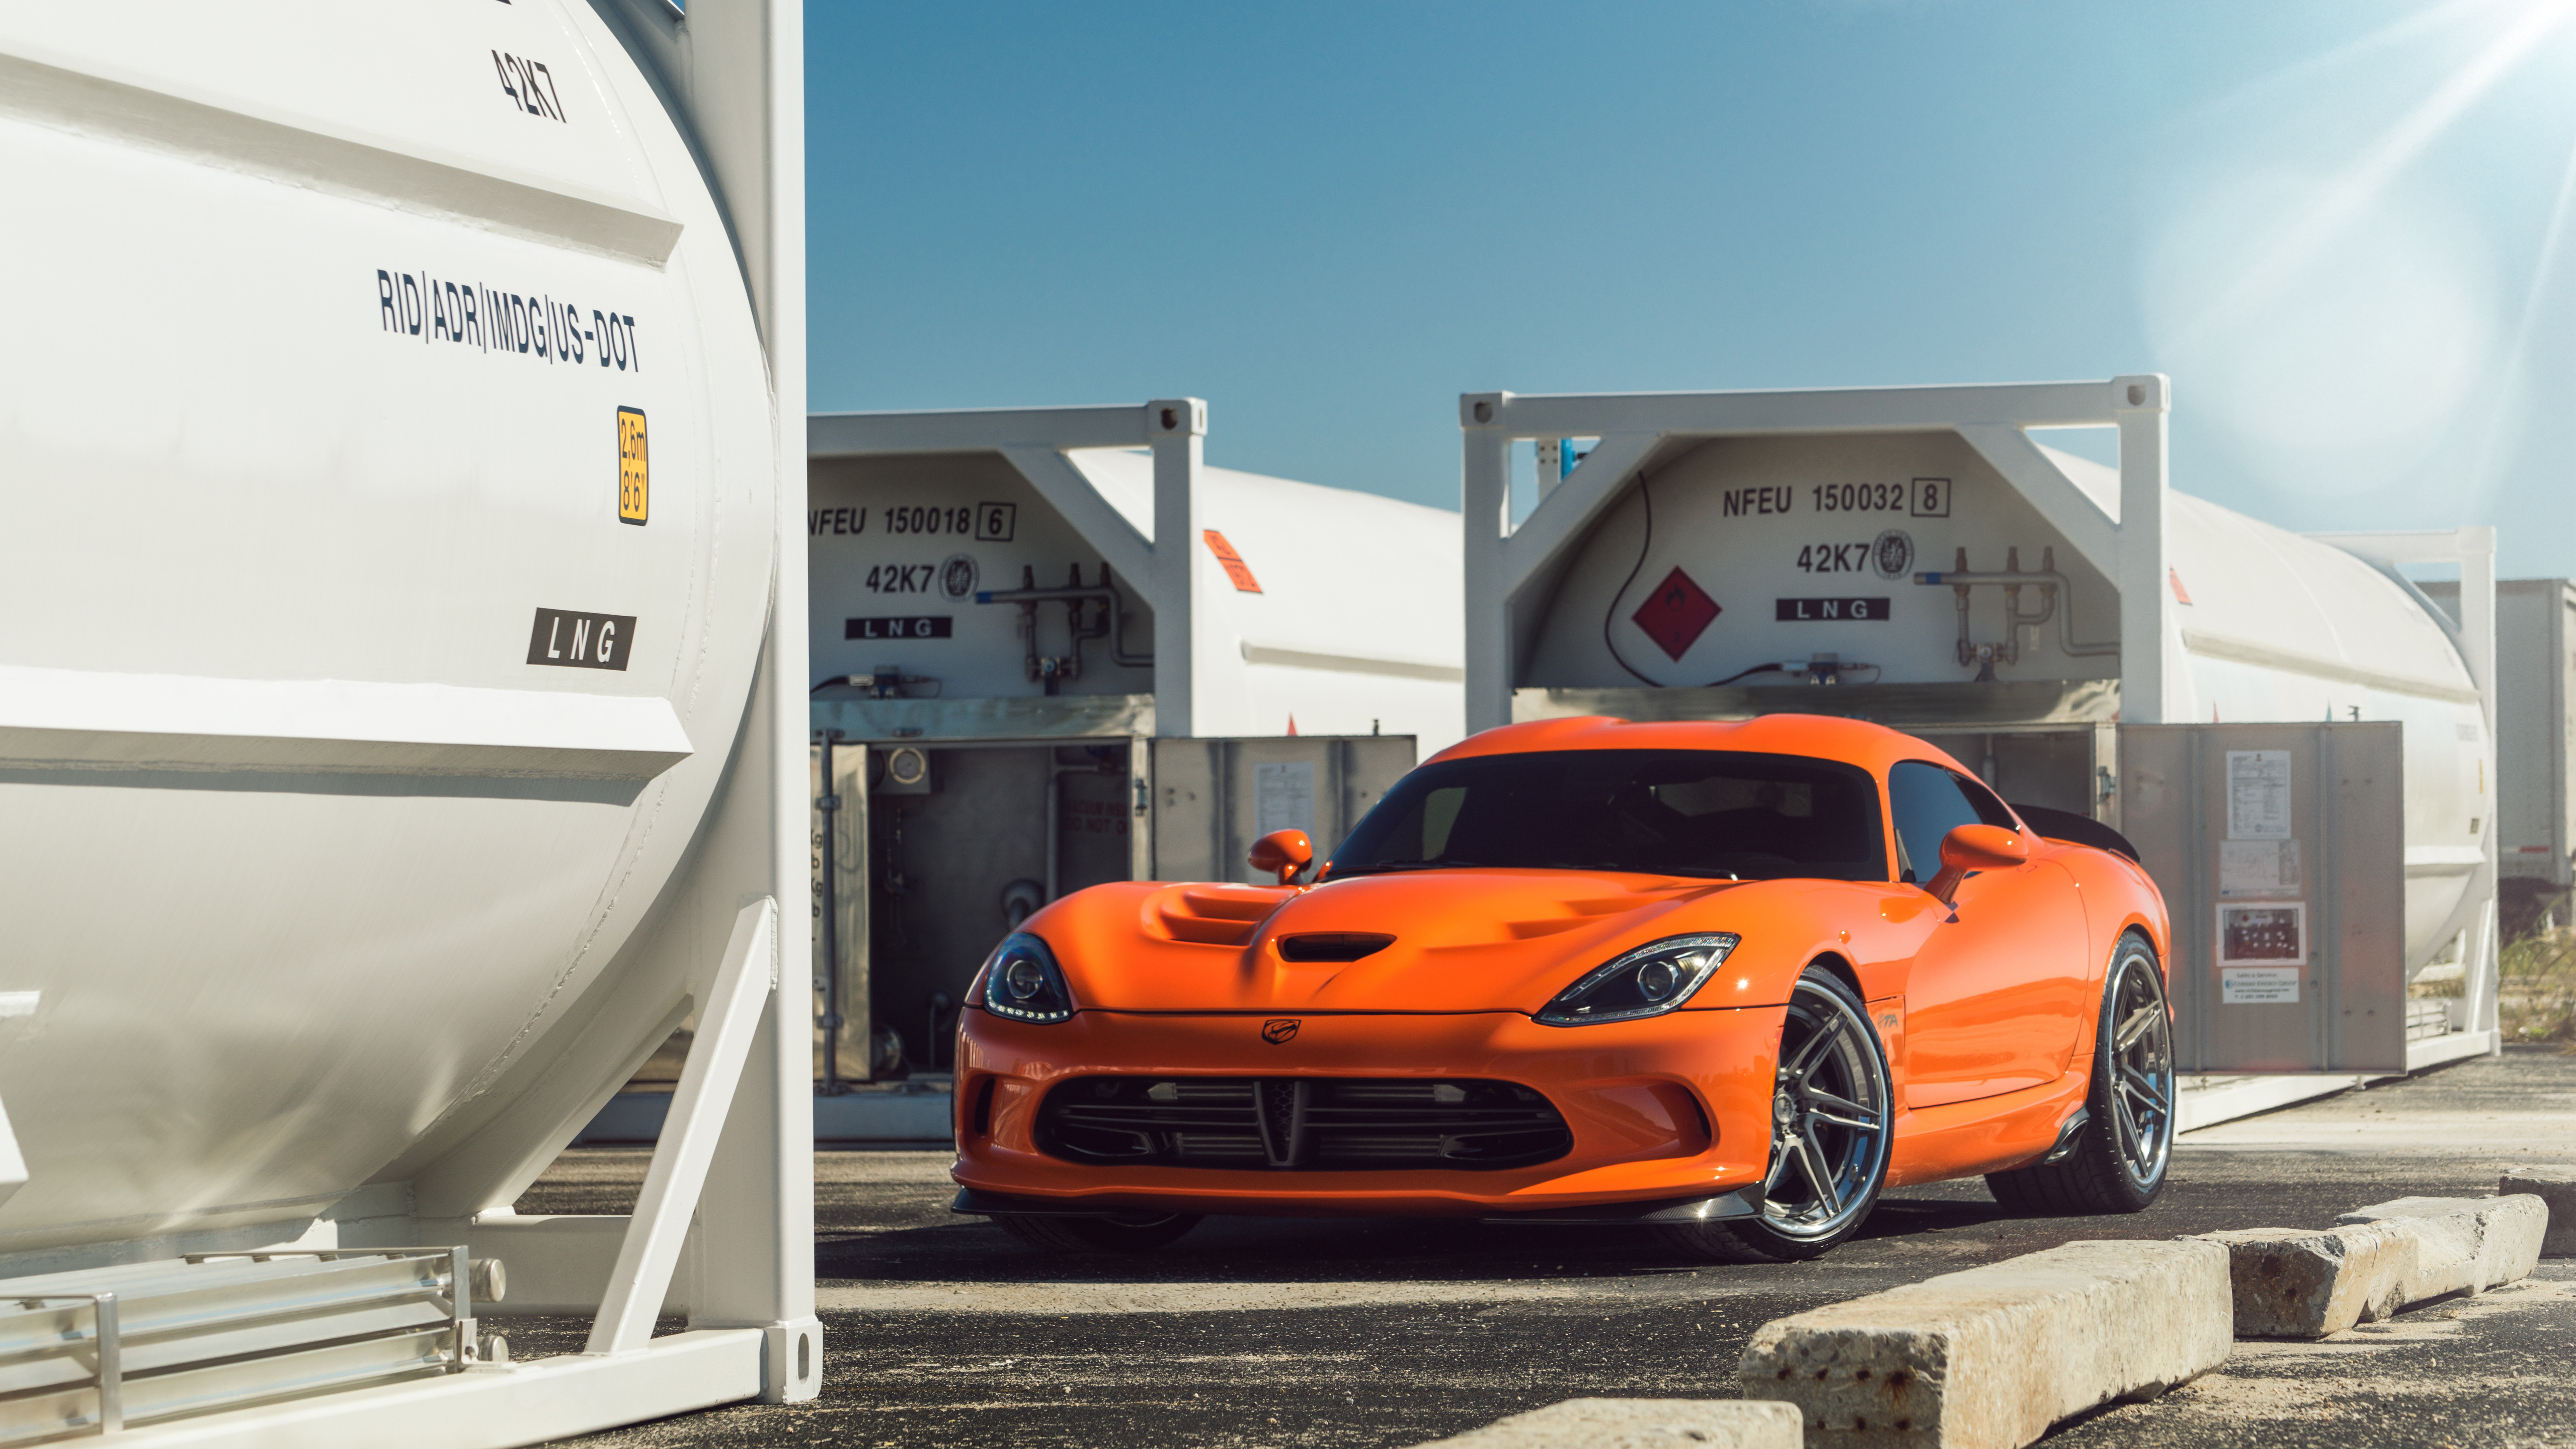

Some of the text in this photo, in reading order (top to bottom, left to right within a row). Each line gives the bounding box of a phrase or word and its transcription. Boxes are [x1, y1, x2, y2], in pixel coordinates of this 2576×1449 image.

[491, 49, 567, 124] 42K7
[377, 269, 638, 373] RID/ADR/IMDG/US-DOT
[621, 418, 646, 468] 2,6m
[1723, 482, 1938, 517] NFEU 150032 8
[884, 506, 971, 534] 150018
[989, 509, 1004, 535] 6
[1797, 543, 1871, 573] 42K7
[865, 565, 935, 593] 42K7
[547, 616, 615, 663] LNG
